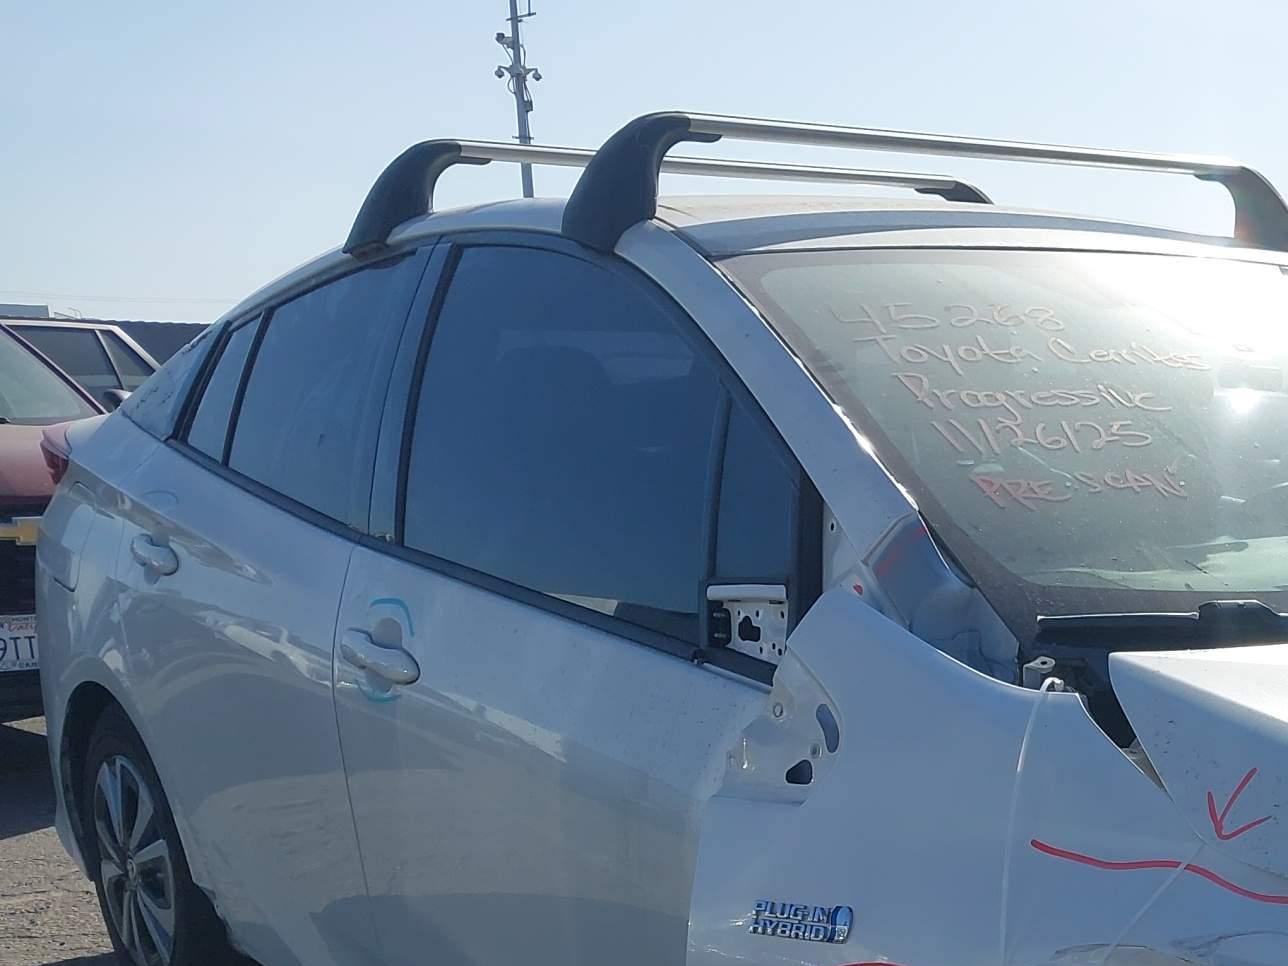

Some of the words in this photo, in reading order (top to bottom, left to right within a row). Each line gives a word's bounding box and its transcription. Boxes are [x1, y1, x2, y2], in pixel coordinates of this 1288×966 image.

[853, 335, 1042, 377] Toyota
[972, 472, 1072, 512] PRE
[752, 900, 831, 923] PLUG-IN
[749, 919, 828, 942] HYBRID
